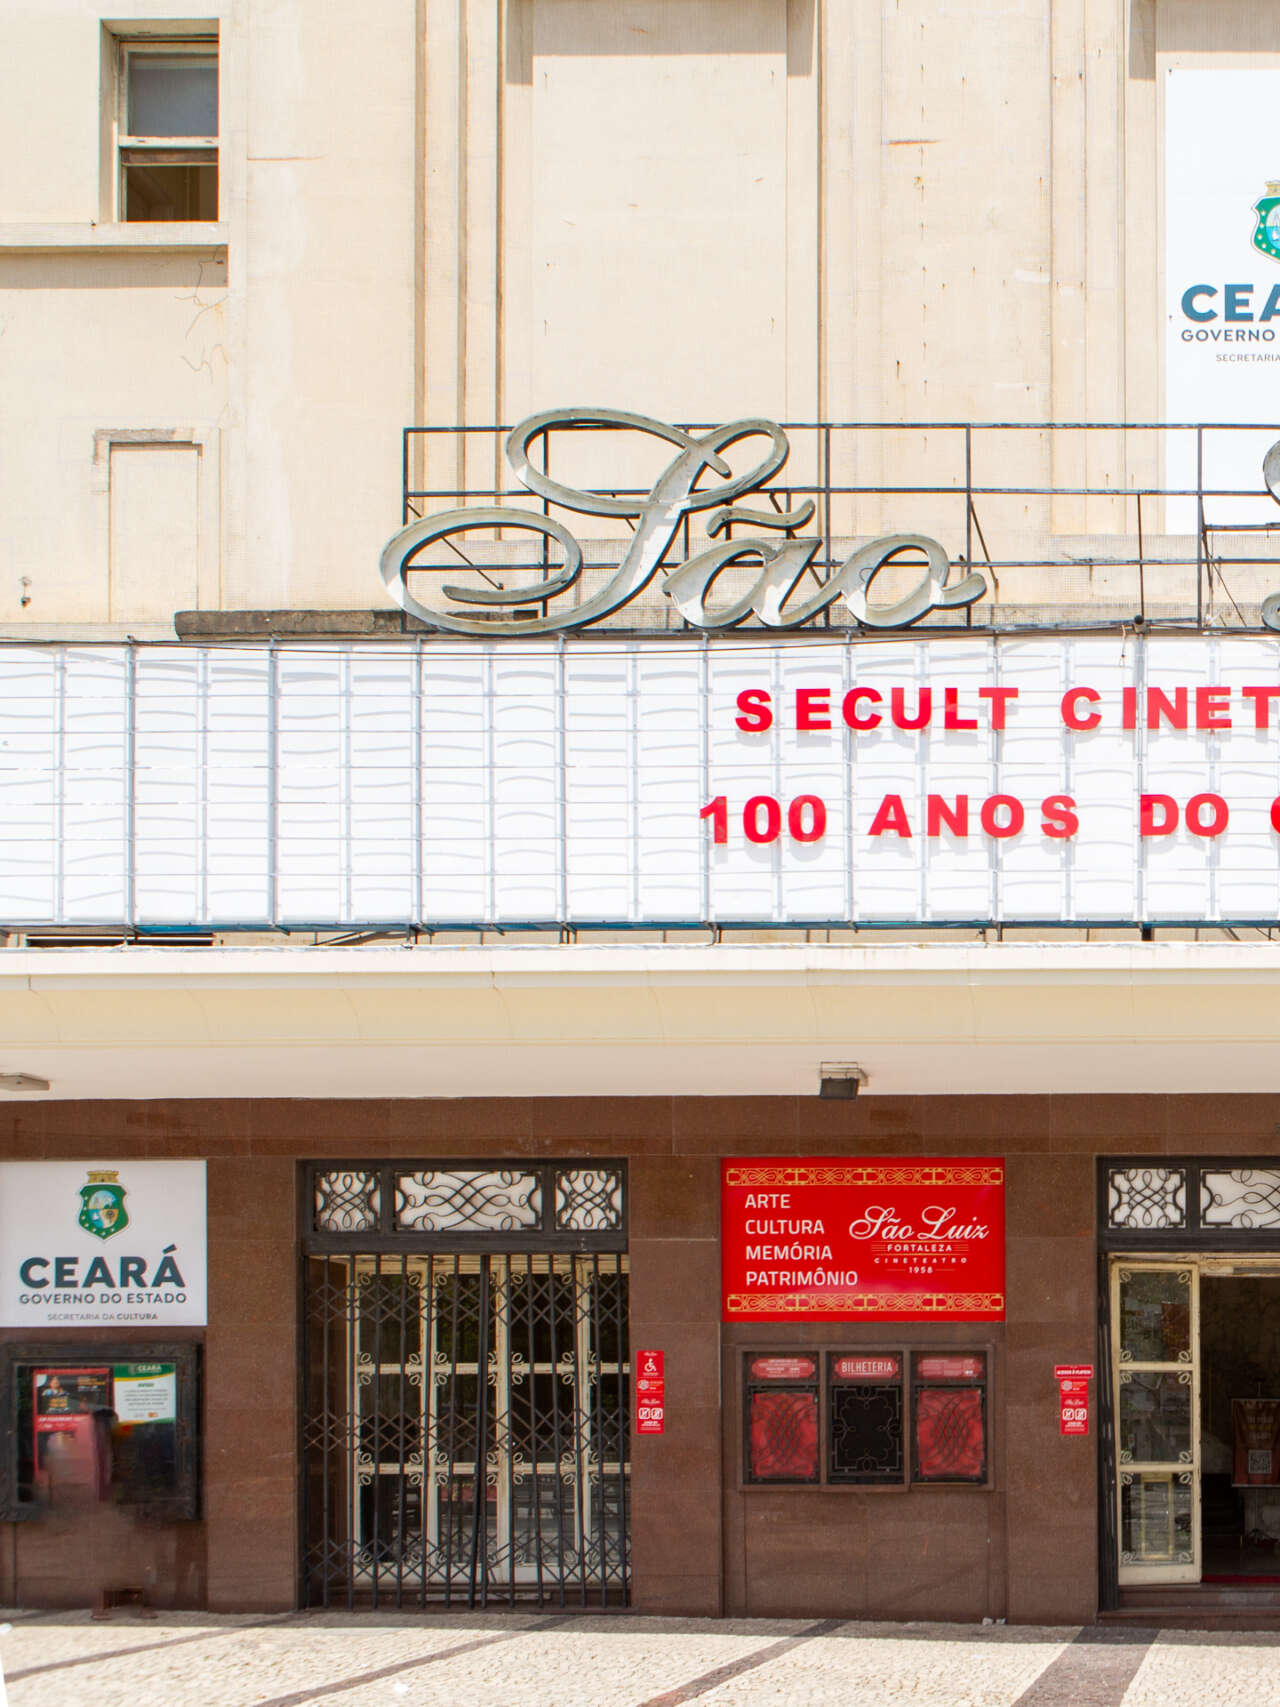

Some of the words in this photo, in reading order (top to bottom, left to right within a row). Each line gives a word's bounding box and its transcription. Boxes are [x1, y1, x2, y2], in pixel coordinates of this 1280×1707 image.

[1181, 329, 1275, 342] GOVERNO
[379, 406, 987, 636] São
[734, 686, 1020, 732] SECULT
[699, 795, 828, 844] 100
[867, 794, 1080, 839] ANOS
[1139, 793, 1230, 838] DO
[745, 1194, 791, 1209] ARTE
[745, 1219, 825, 1235] CULTURA
[849, 1206, 914, 1240] São
[917, 1206, 989, 1240] Luiz
[746, 1242, 833, 1261] MEMÓRIA
[887, 1244, 952, 1252] FORTALEZA
[19, 1243, 186, 1289] CEARÁ
[908, 1266, 933, 1274] 1958
[746, 1267, 858, 1286] PATRIMÔNIO
[19, 1293, 95, 1304] GOVERNO
[100, 1293, 122, 1304] DO
[127, 1293, 187, 1304] ESTADO
[48, 1313, 100, 1321] SECRETARIA
[102, 1313, 115, 1321] DA
[116, 1312, 158, 1320] CULTURA
[841, 1362, 893, 1373] BILHETERIA
